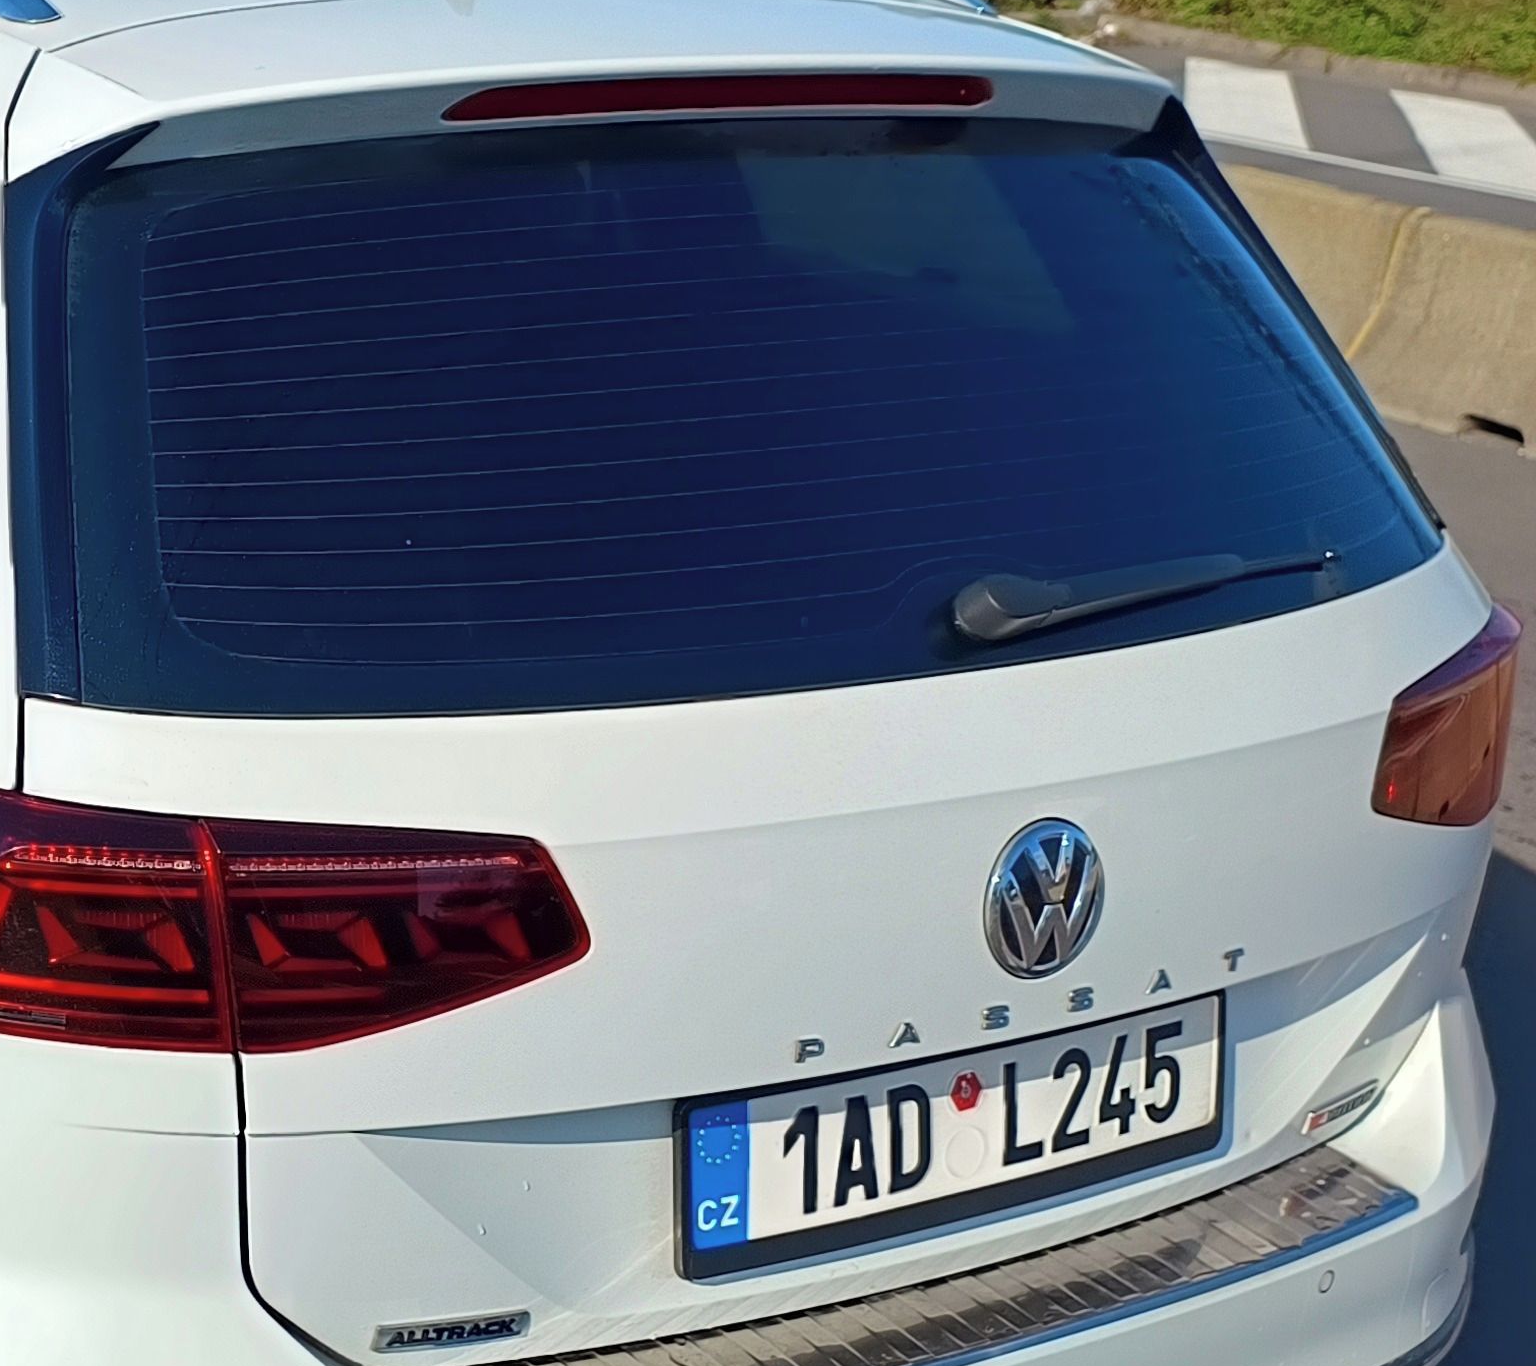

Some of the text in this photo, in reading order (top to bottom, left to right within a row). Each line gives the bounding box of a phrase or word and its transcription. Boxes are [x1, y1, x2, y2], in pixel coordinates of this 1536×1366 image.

[794, 947, 1246, 1065] PASSAT
[782, 1019, 1184, 1216] 1AD L245
[697, 1194, 739, 1232] CZ
[384, 1317, 519, 1348] ALLTRACK
